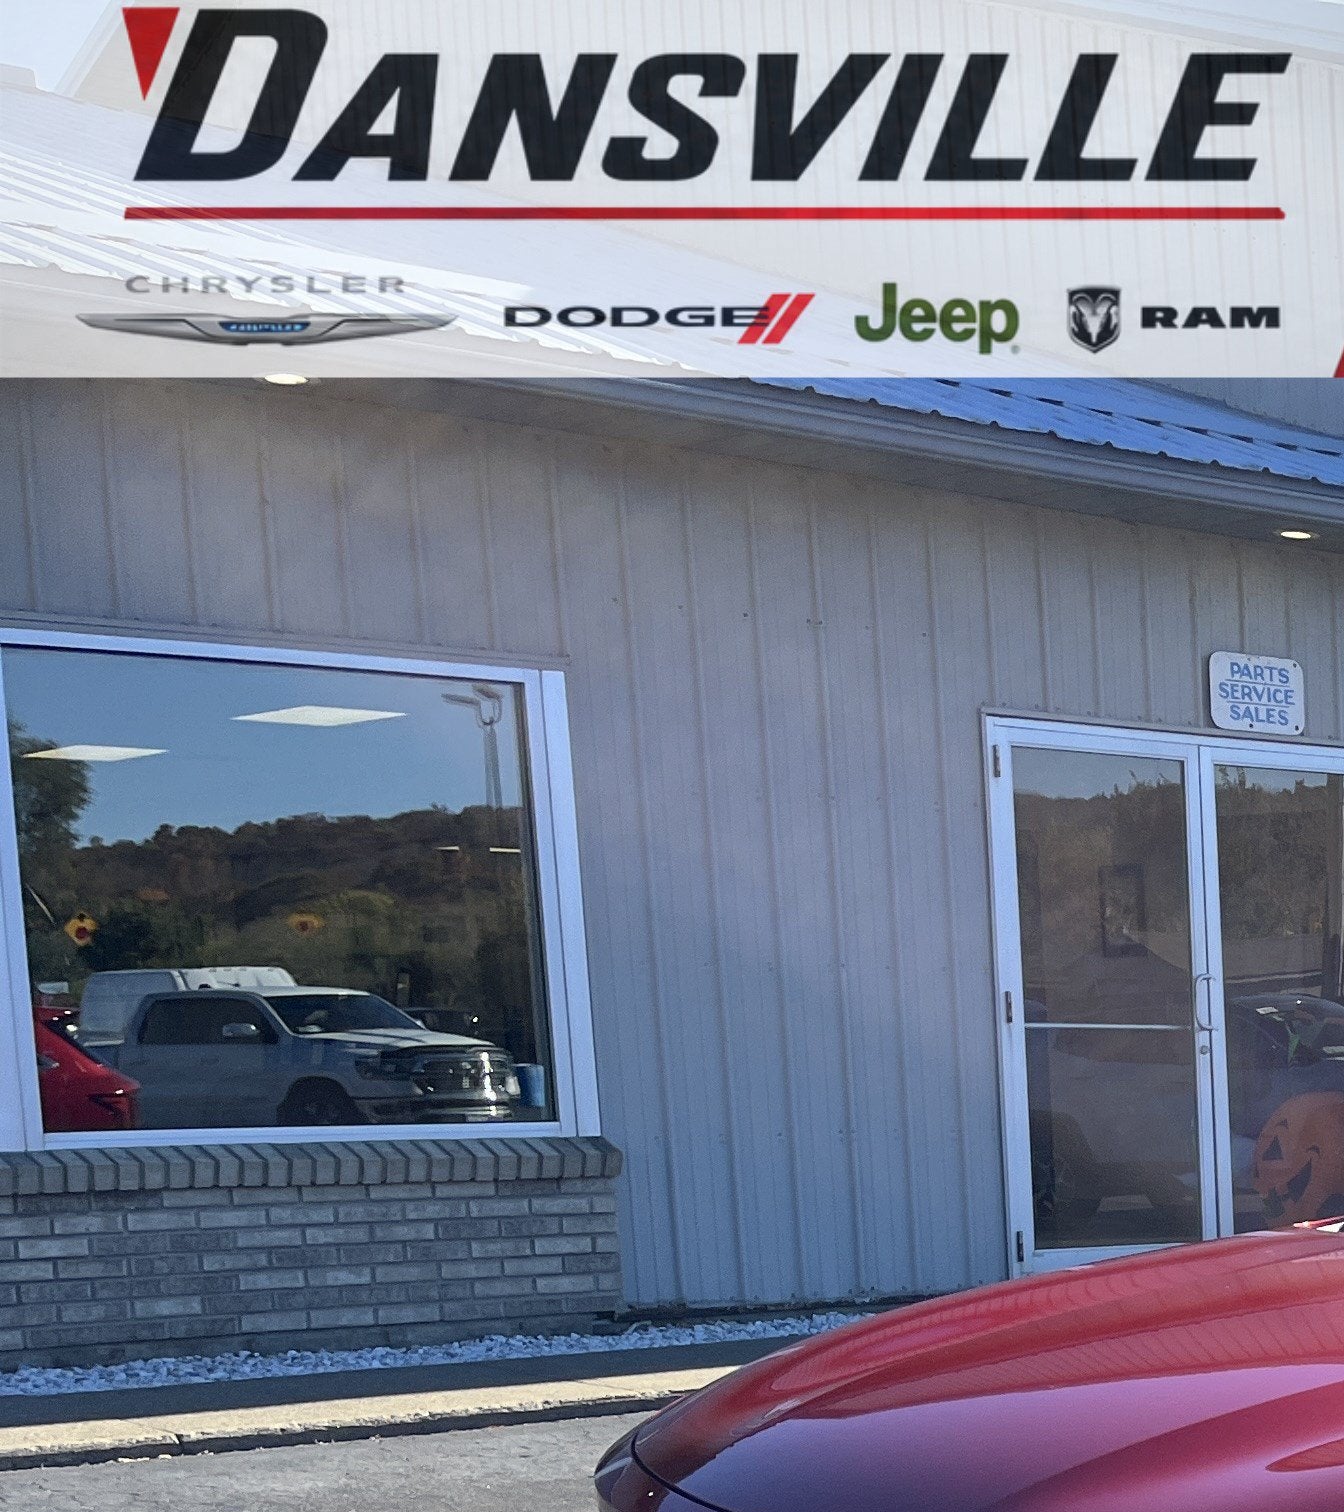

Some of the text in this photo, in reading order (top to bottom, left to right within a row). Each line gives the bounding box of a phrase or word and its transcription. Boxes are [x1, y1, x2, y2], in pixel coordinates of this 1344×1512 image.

[1229, 661, 1290, 685] PARTS
[1218, 682, 1296, 706] SERVICE
[1229, 704, 1289, 727] SALES
